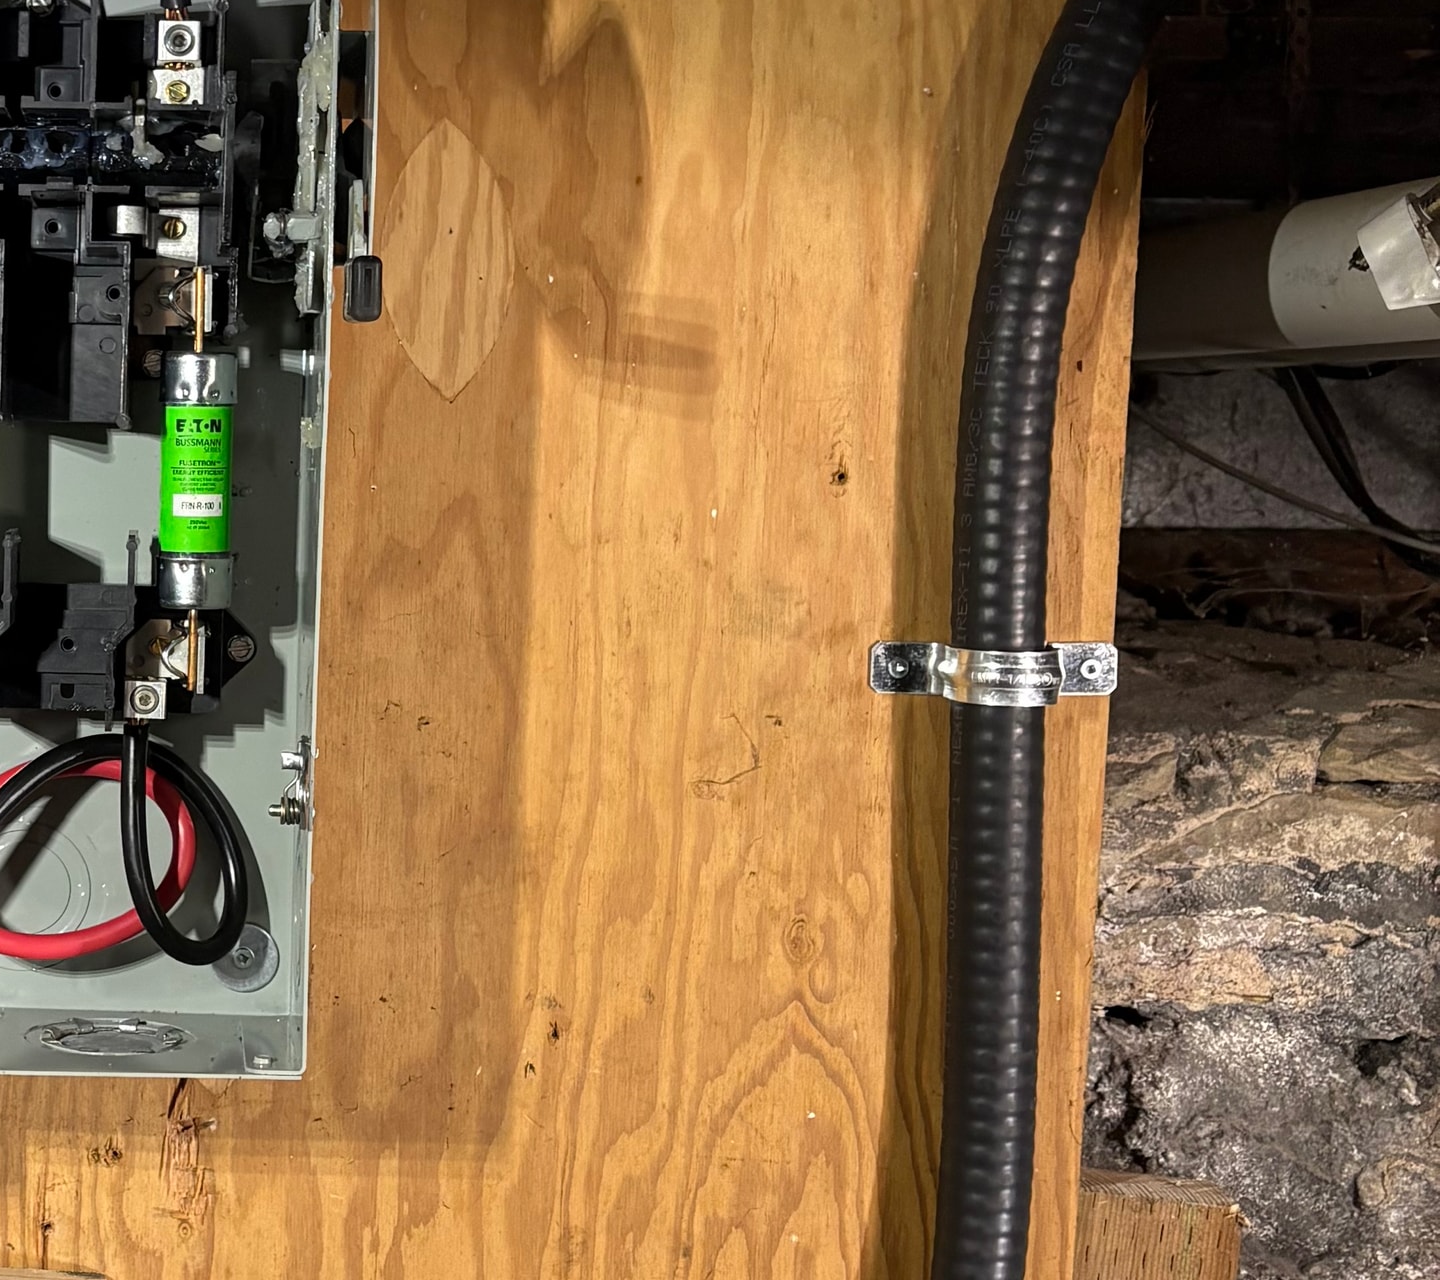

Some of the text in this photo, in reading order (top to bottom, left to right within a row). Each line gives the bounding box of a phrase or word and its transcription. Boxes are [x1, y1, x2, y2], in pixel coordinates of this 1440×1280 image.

[1050, 42, 1081, 87] CSA
[1015, 105, 1052, 187] (-40C)
[993, 208, 1023, 269] XLPE
[985, 285, 1002, 313] 90
[972, 328, 995, 390] TECK
[175, 438, 221, 446] BUSSMANN
[960, 512, 973, 526] 3
[955, 545, 971, 644] IREX-II
